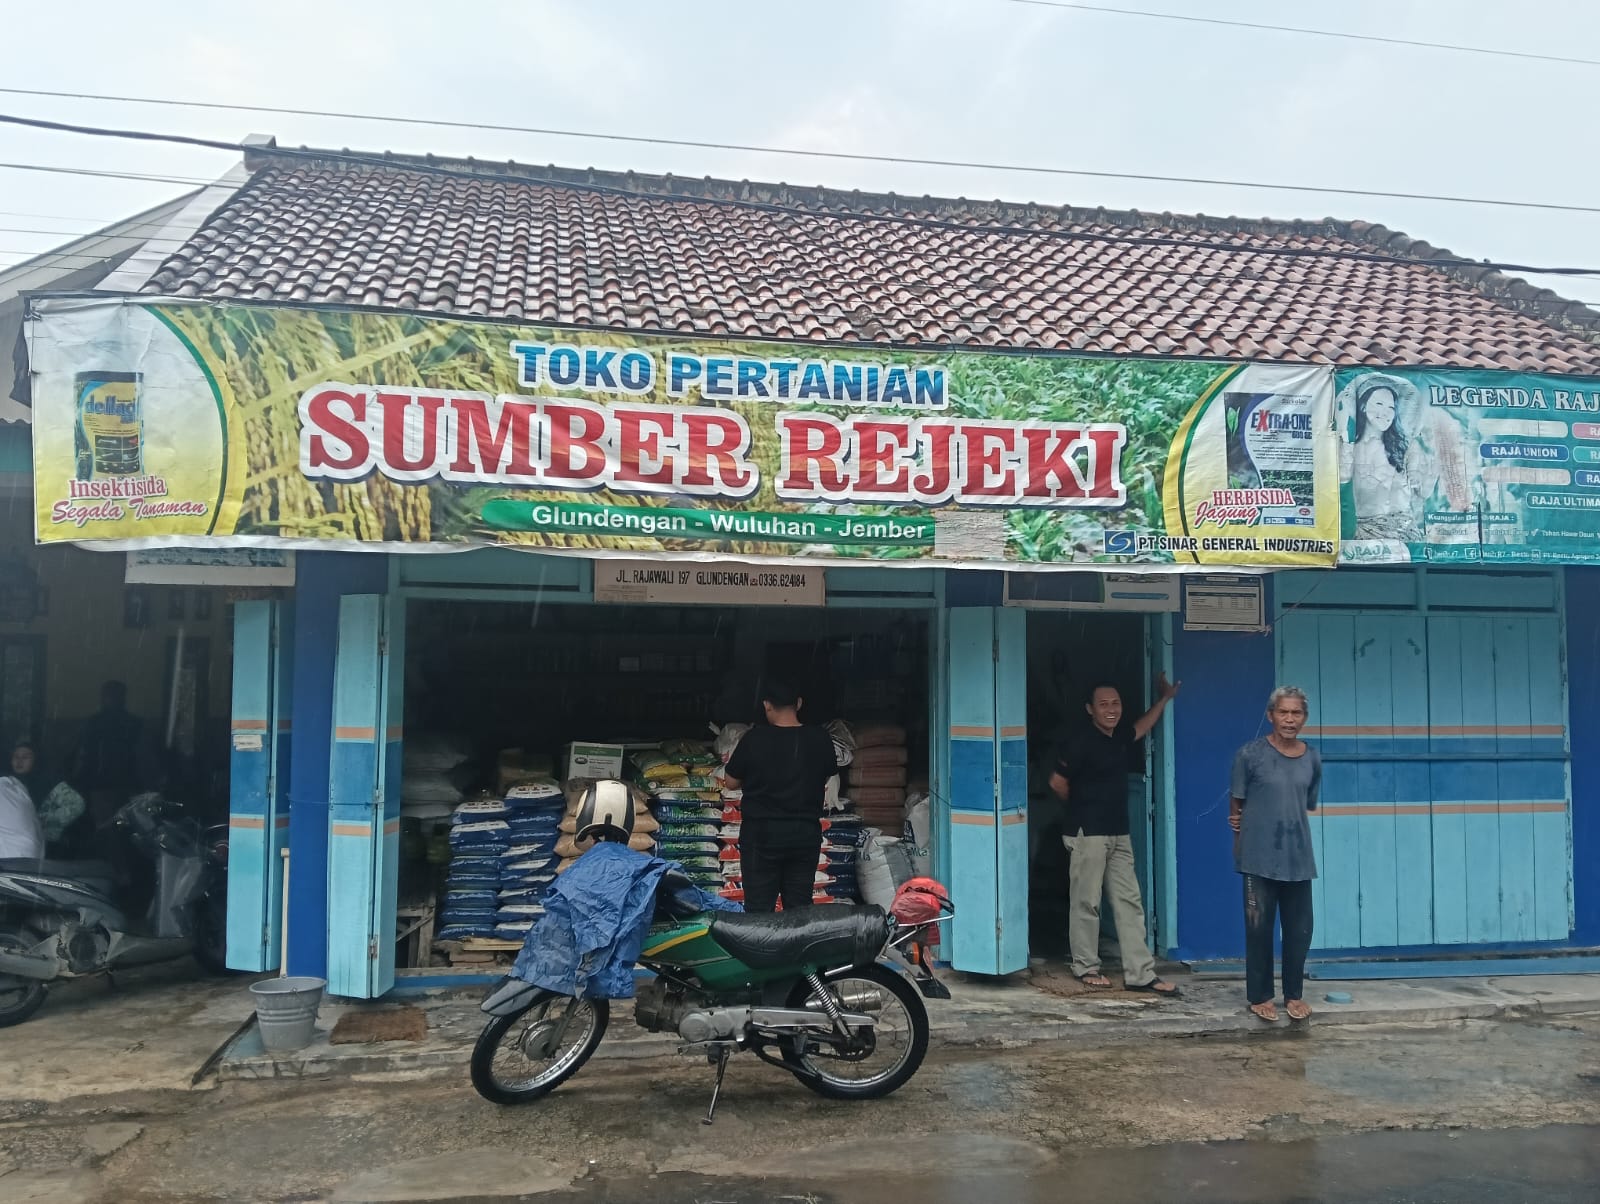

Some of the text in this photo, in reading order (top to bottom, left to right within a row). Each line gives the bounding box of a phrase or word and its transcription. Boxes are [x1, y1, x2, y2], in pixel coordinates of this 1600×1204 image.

[514, 344, 945, 405] TOKO PERTANIAN
[1430, 385, 1548, 408] LEGENDA
[306, 390, 1121, 499] SUMBER REJEKI
[1491, 446, 1558, 458] RAJA UNION
[69, 475, 167, 498] Insektisida
[1213, 490, 1294, 506] HERBISIDA
[52, 498, 206, 525] Segala Tanaman
[1532, 496, 1561, 506] RAJA
[531, 504, 687, 532] Glundengan
[710, 513, 816, 537] Wuluhan
[837, 518, 927, 540] Jember
[1194, 502, 1258, 526] Jagung
[1138, 536, 1334, 554] PT SINAR GENERAL INDUSTRIES
[633, 570, 674, 585] RAJAWALI
[678, 571, 690, 585] 197
[696, 571, 750, 586] GLUNDENGAN
